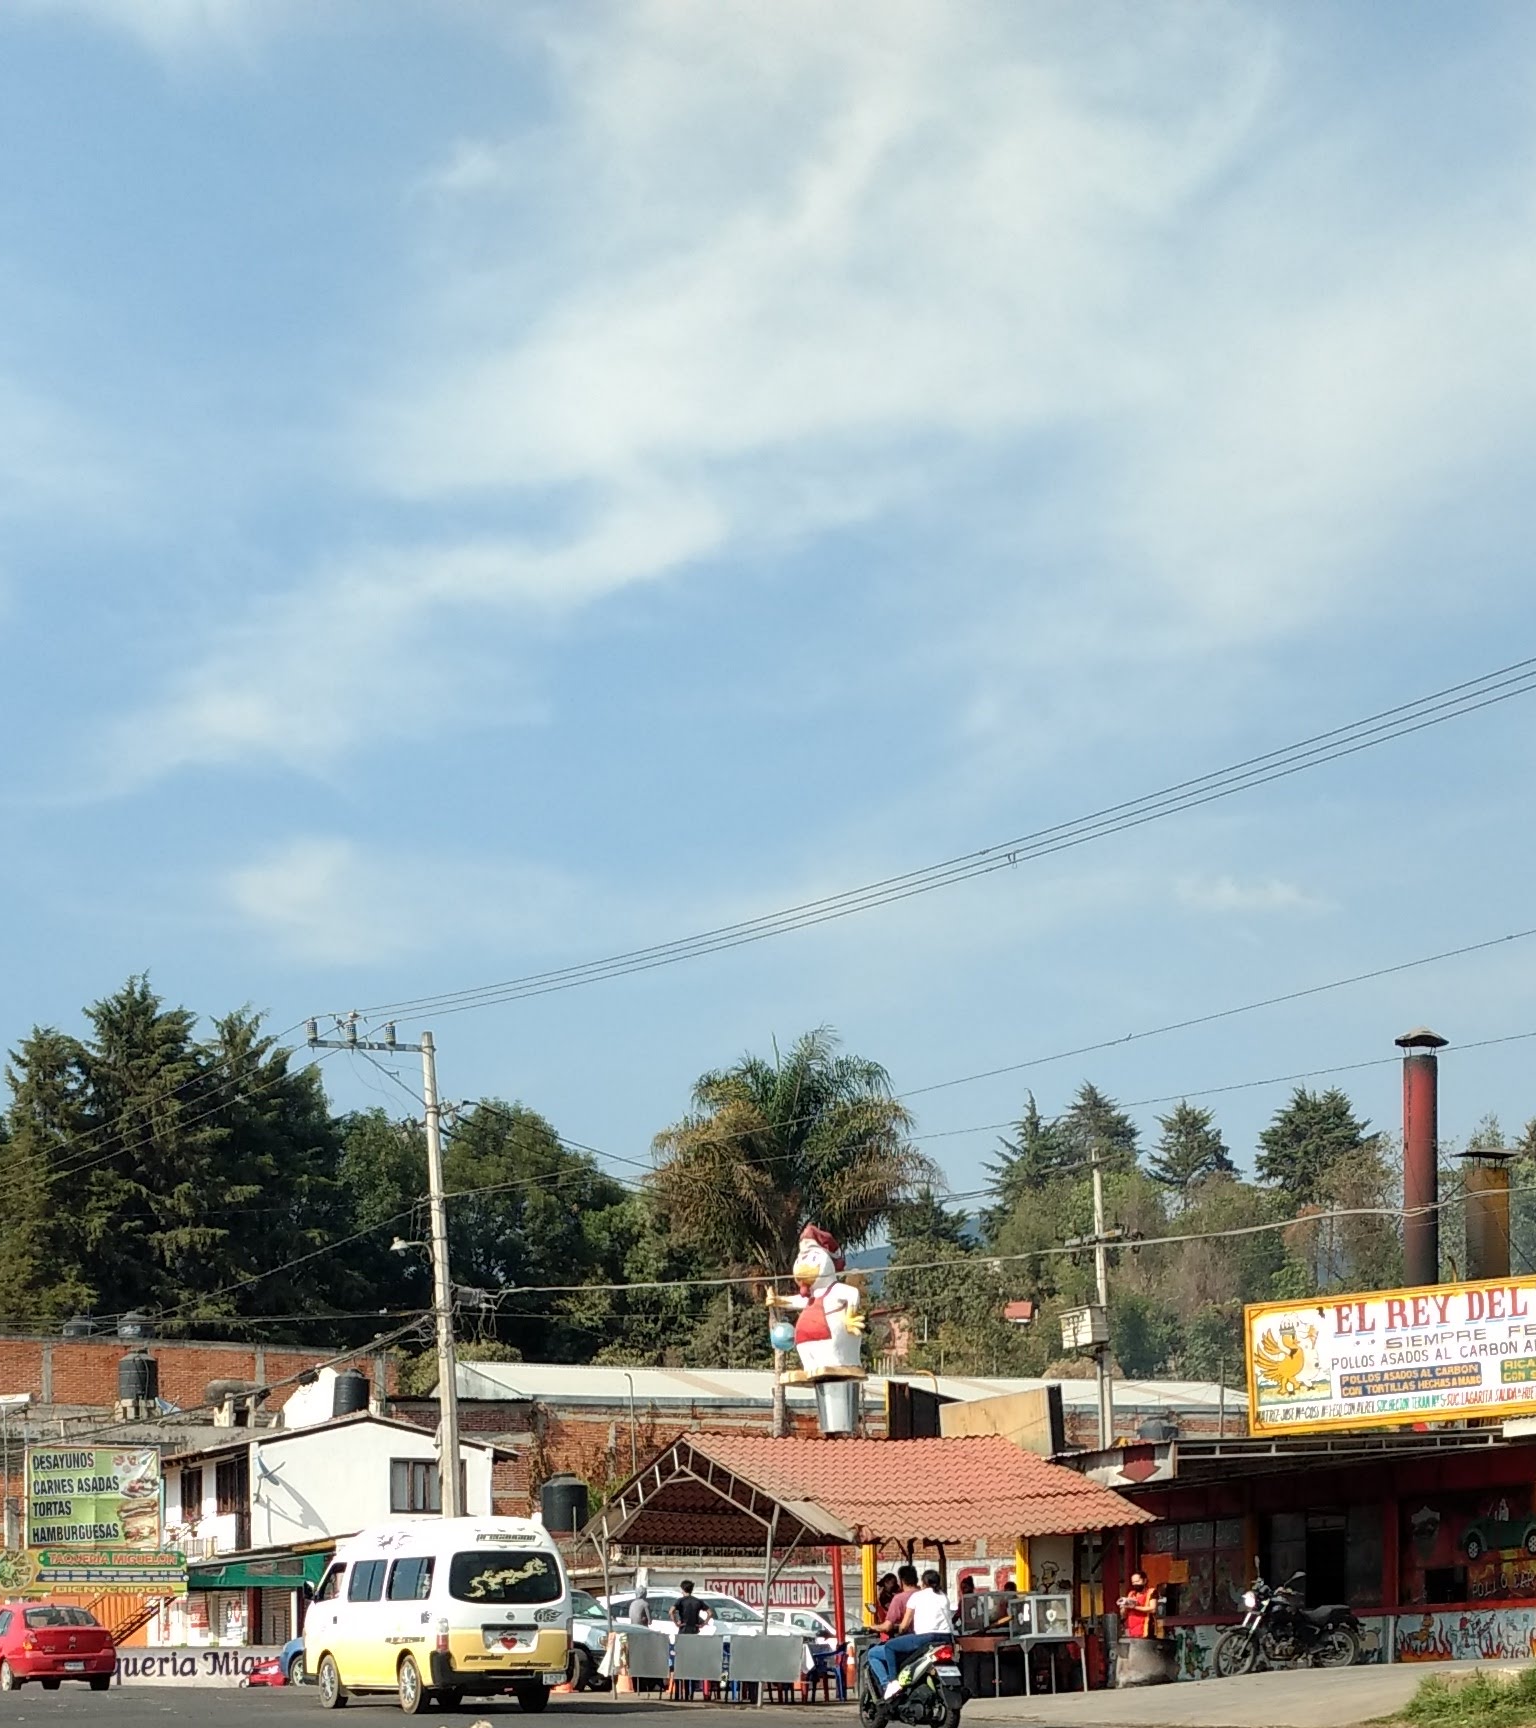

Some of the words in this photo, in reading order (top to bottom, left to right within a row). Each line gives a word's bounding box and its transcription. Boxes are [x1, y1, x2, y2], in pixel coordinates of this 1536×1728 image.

[1333, 1302, 1375, 1335] EL
[1385, 1293, 1453, 1330] REY
[1465, 1286, 1527, 1321] DEL
[1385, 1328, 1487, 1349] SIEMPRE
[1332, 1354, 1375, 1371] POLLOS
[1380, 1348, 1429, 1366] ASADOS
[1435, 1346, 1452, 1361] AL
[1460, 1340, 1518, 1359] CARBON
[1342, 1373, 1381, 1385] POLLOS
[1383, 1370, 1418, 1381] ASADOS
[1420, 1368, 1433, 1377] AL
[1435, 1363, 1479, 1377] CARBON
[1504, 1371, 1525, 1382] CON
[1342, 1385, 1363, 1396] CON
[1366, 1381, 1416, 1395] TORTILLAS
[32, 1452, 94, 1470] DESAYUNOS
[33, 1478, 74, 1495] CARNES
[77, 1475, 120, 1493] ASADAS
[32, 1501, 72, 1517] TORTAS
[32, 1523, 119, 1543] HAMBURGUESAS
[55, 1586, 170, 1594] BIENVENIDOS
[112, 1651, 198, 1686] queria
